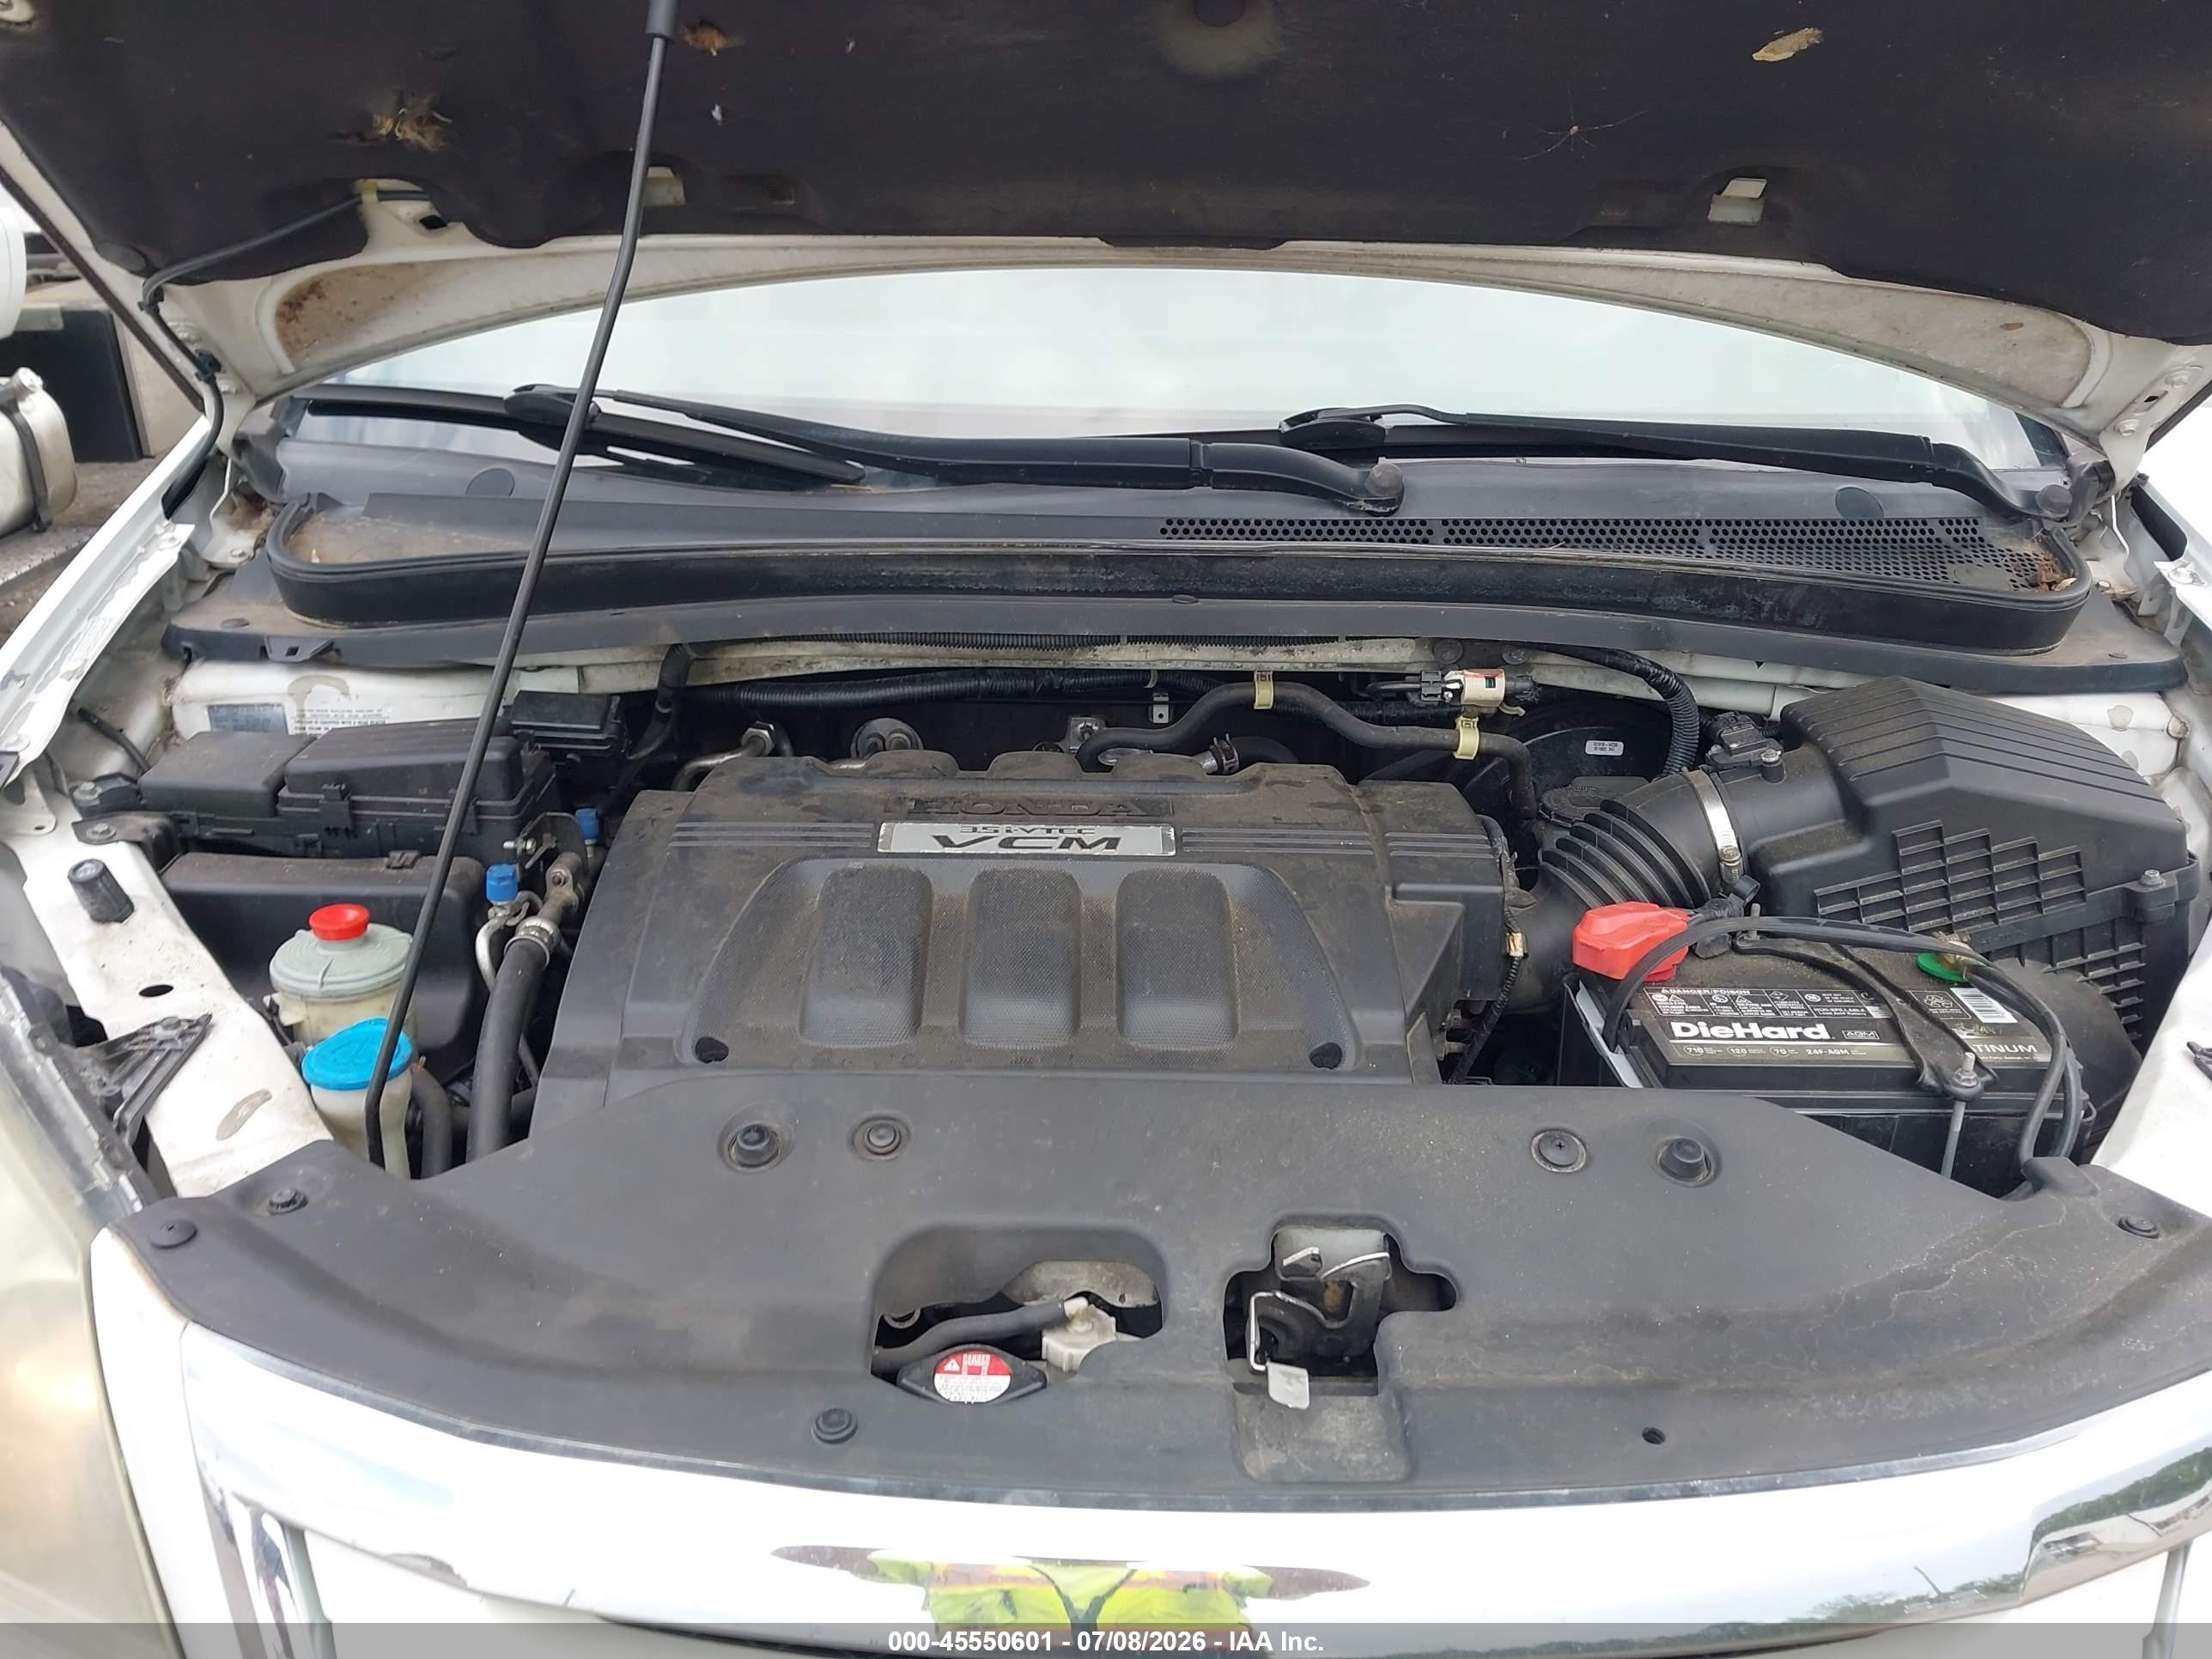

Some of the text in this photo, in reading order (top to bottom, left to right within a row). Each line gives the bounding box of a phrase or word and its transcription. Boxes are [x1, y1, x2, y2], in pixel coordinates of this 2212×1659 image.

[907, 799, 1156, 817] HONDA
[960, 825, 1000, 835] 3.5
[932, 835, 1122, 851] VCM
[1670, 1021, 1831, 1040] DieHard
